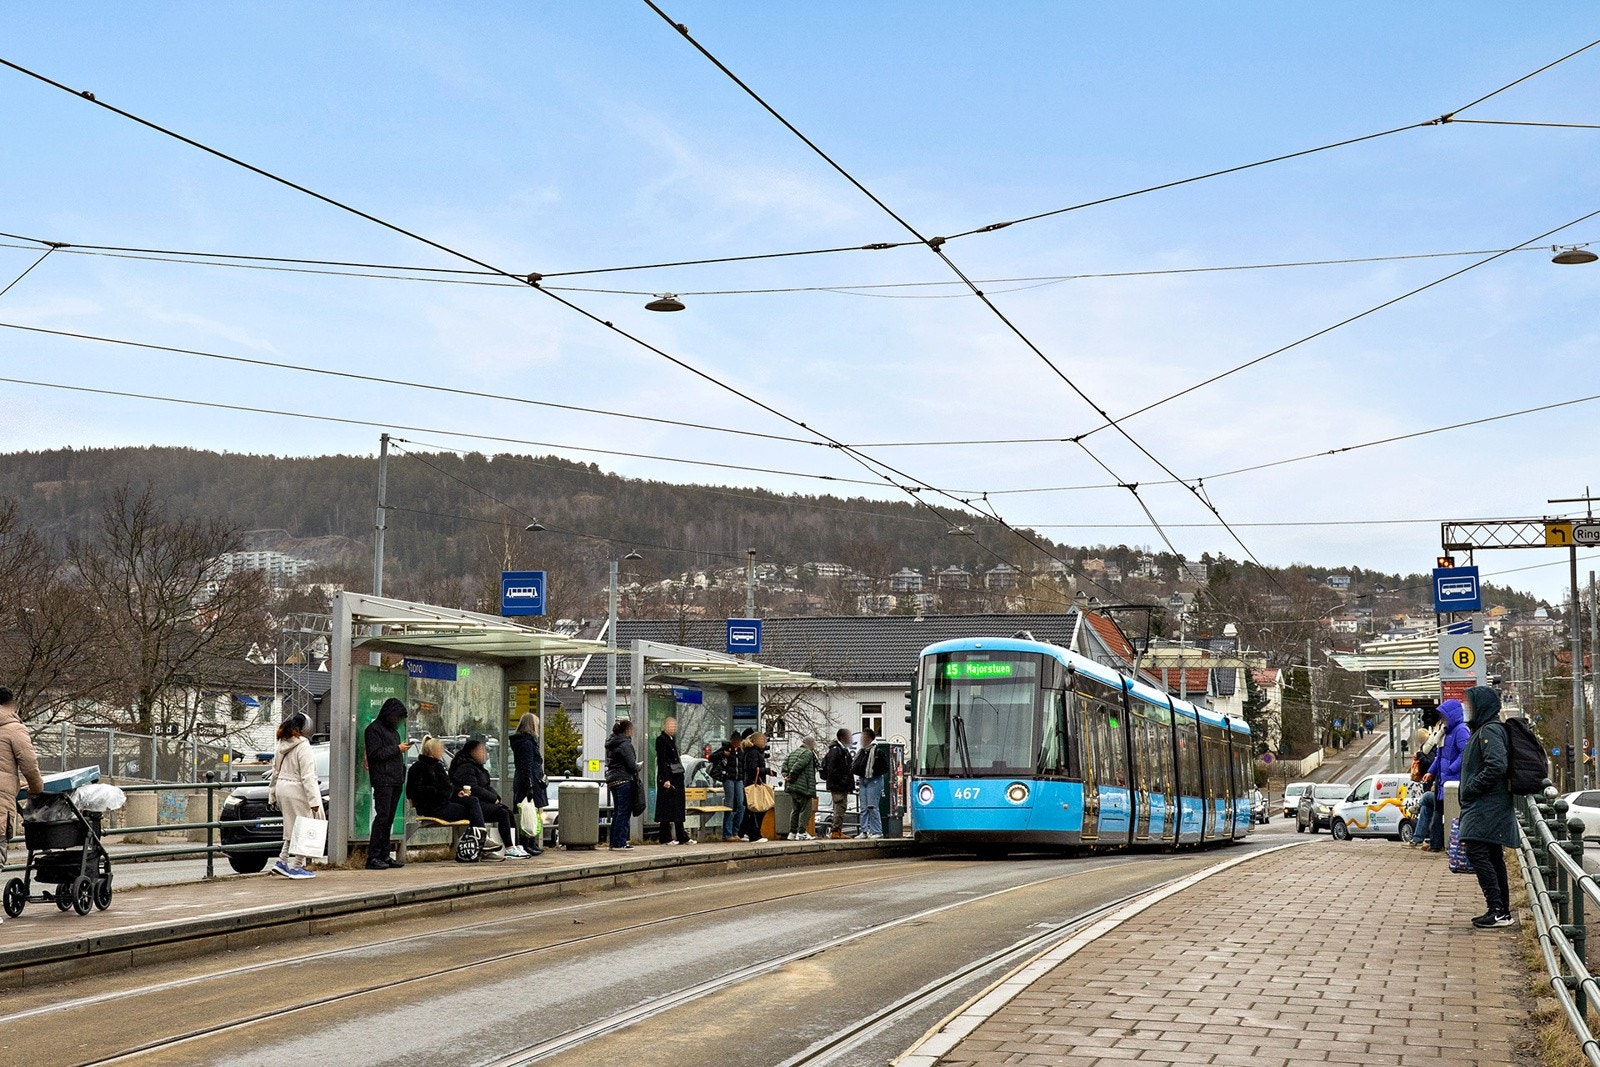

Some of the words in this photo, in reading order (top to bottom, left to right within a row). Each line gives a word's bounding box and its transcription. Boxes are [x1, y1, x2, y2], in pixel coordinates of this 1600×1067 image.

[1577, 529, 1600, 541] Ring
[1458, 651, 1469, 664] B
[946, 664, 958, 675] 15
[966, 663, 1011, 676] Majorstuen
[954, 787, 980, 800] 467
[459, 842, 475, 850] SKIN
